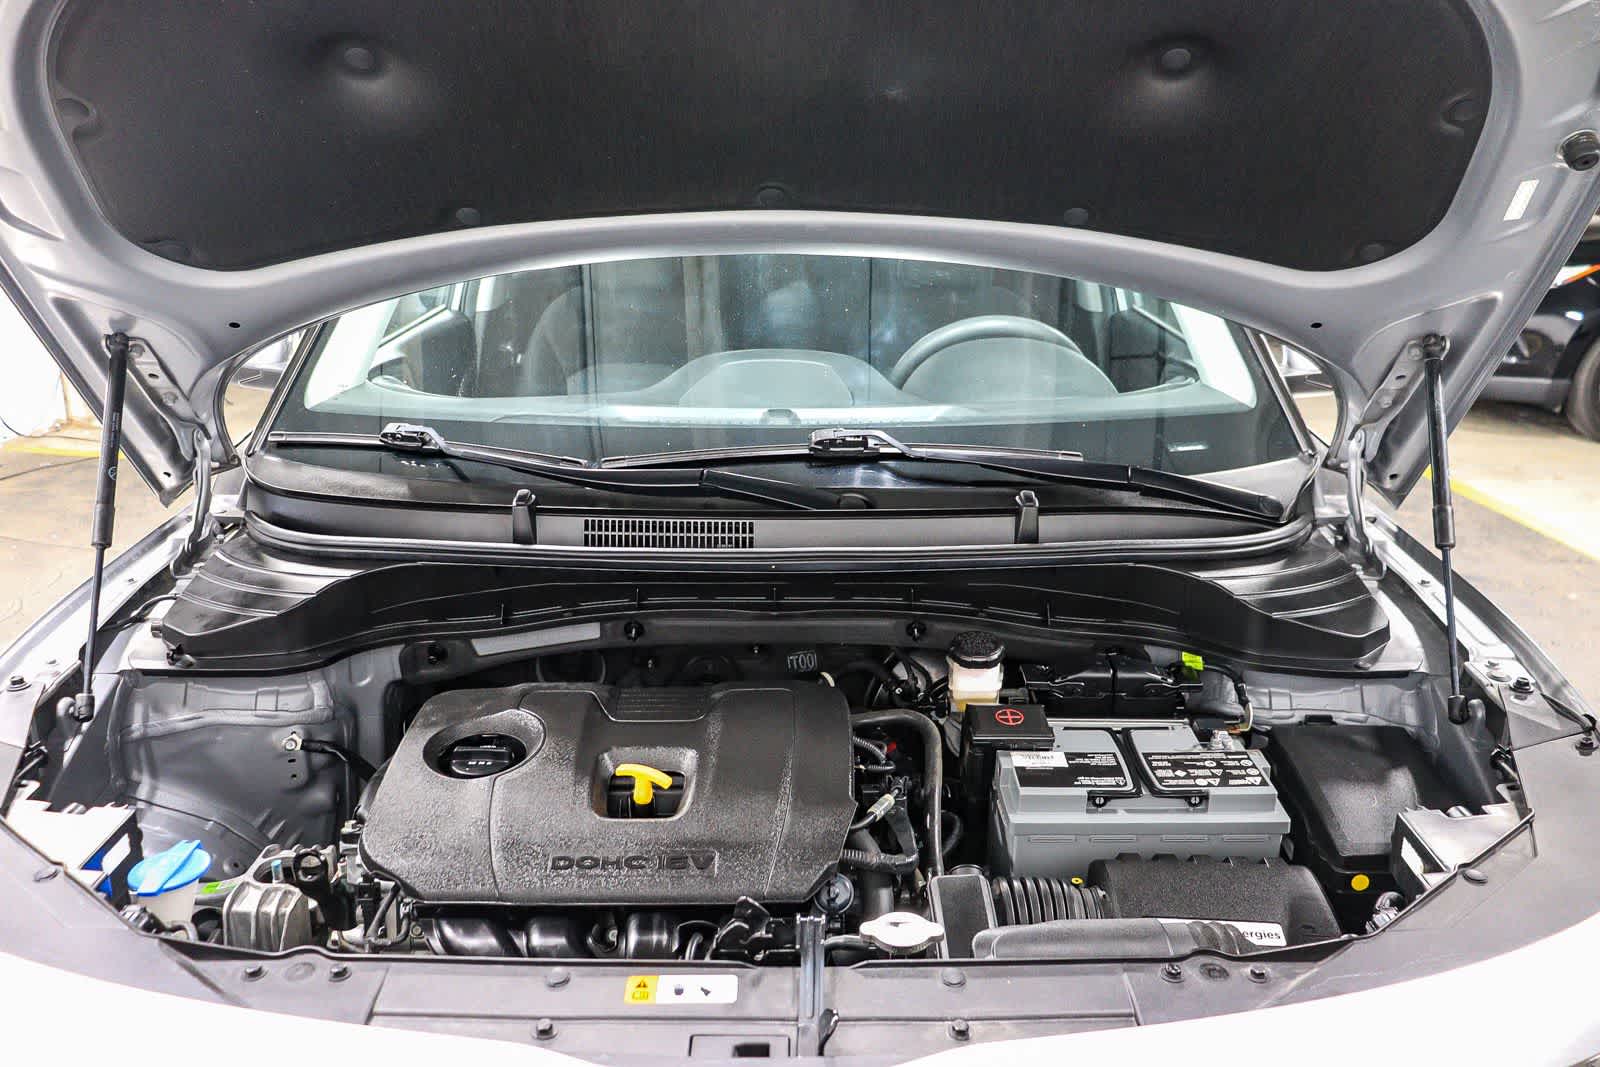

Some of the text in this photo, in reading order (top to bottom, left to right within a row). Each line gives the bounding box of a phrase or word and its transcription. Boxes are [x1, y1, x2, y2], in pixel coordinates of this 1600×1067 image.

[550, 853, 717, 871] DOHC 16V
[1242, 930, 1281, 940] ergies
